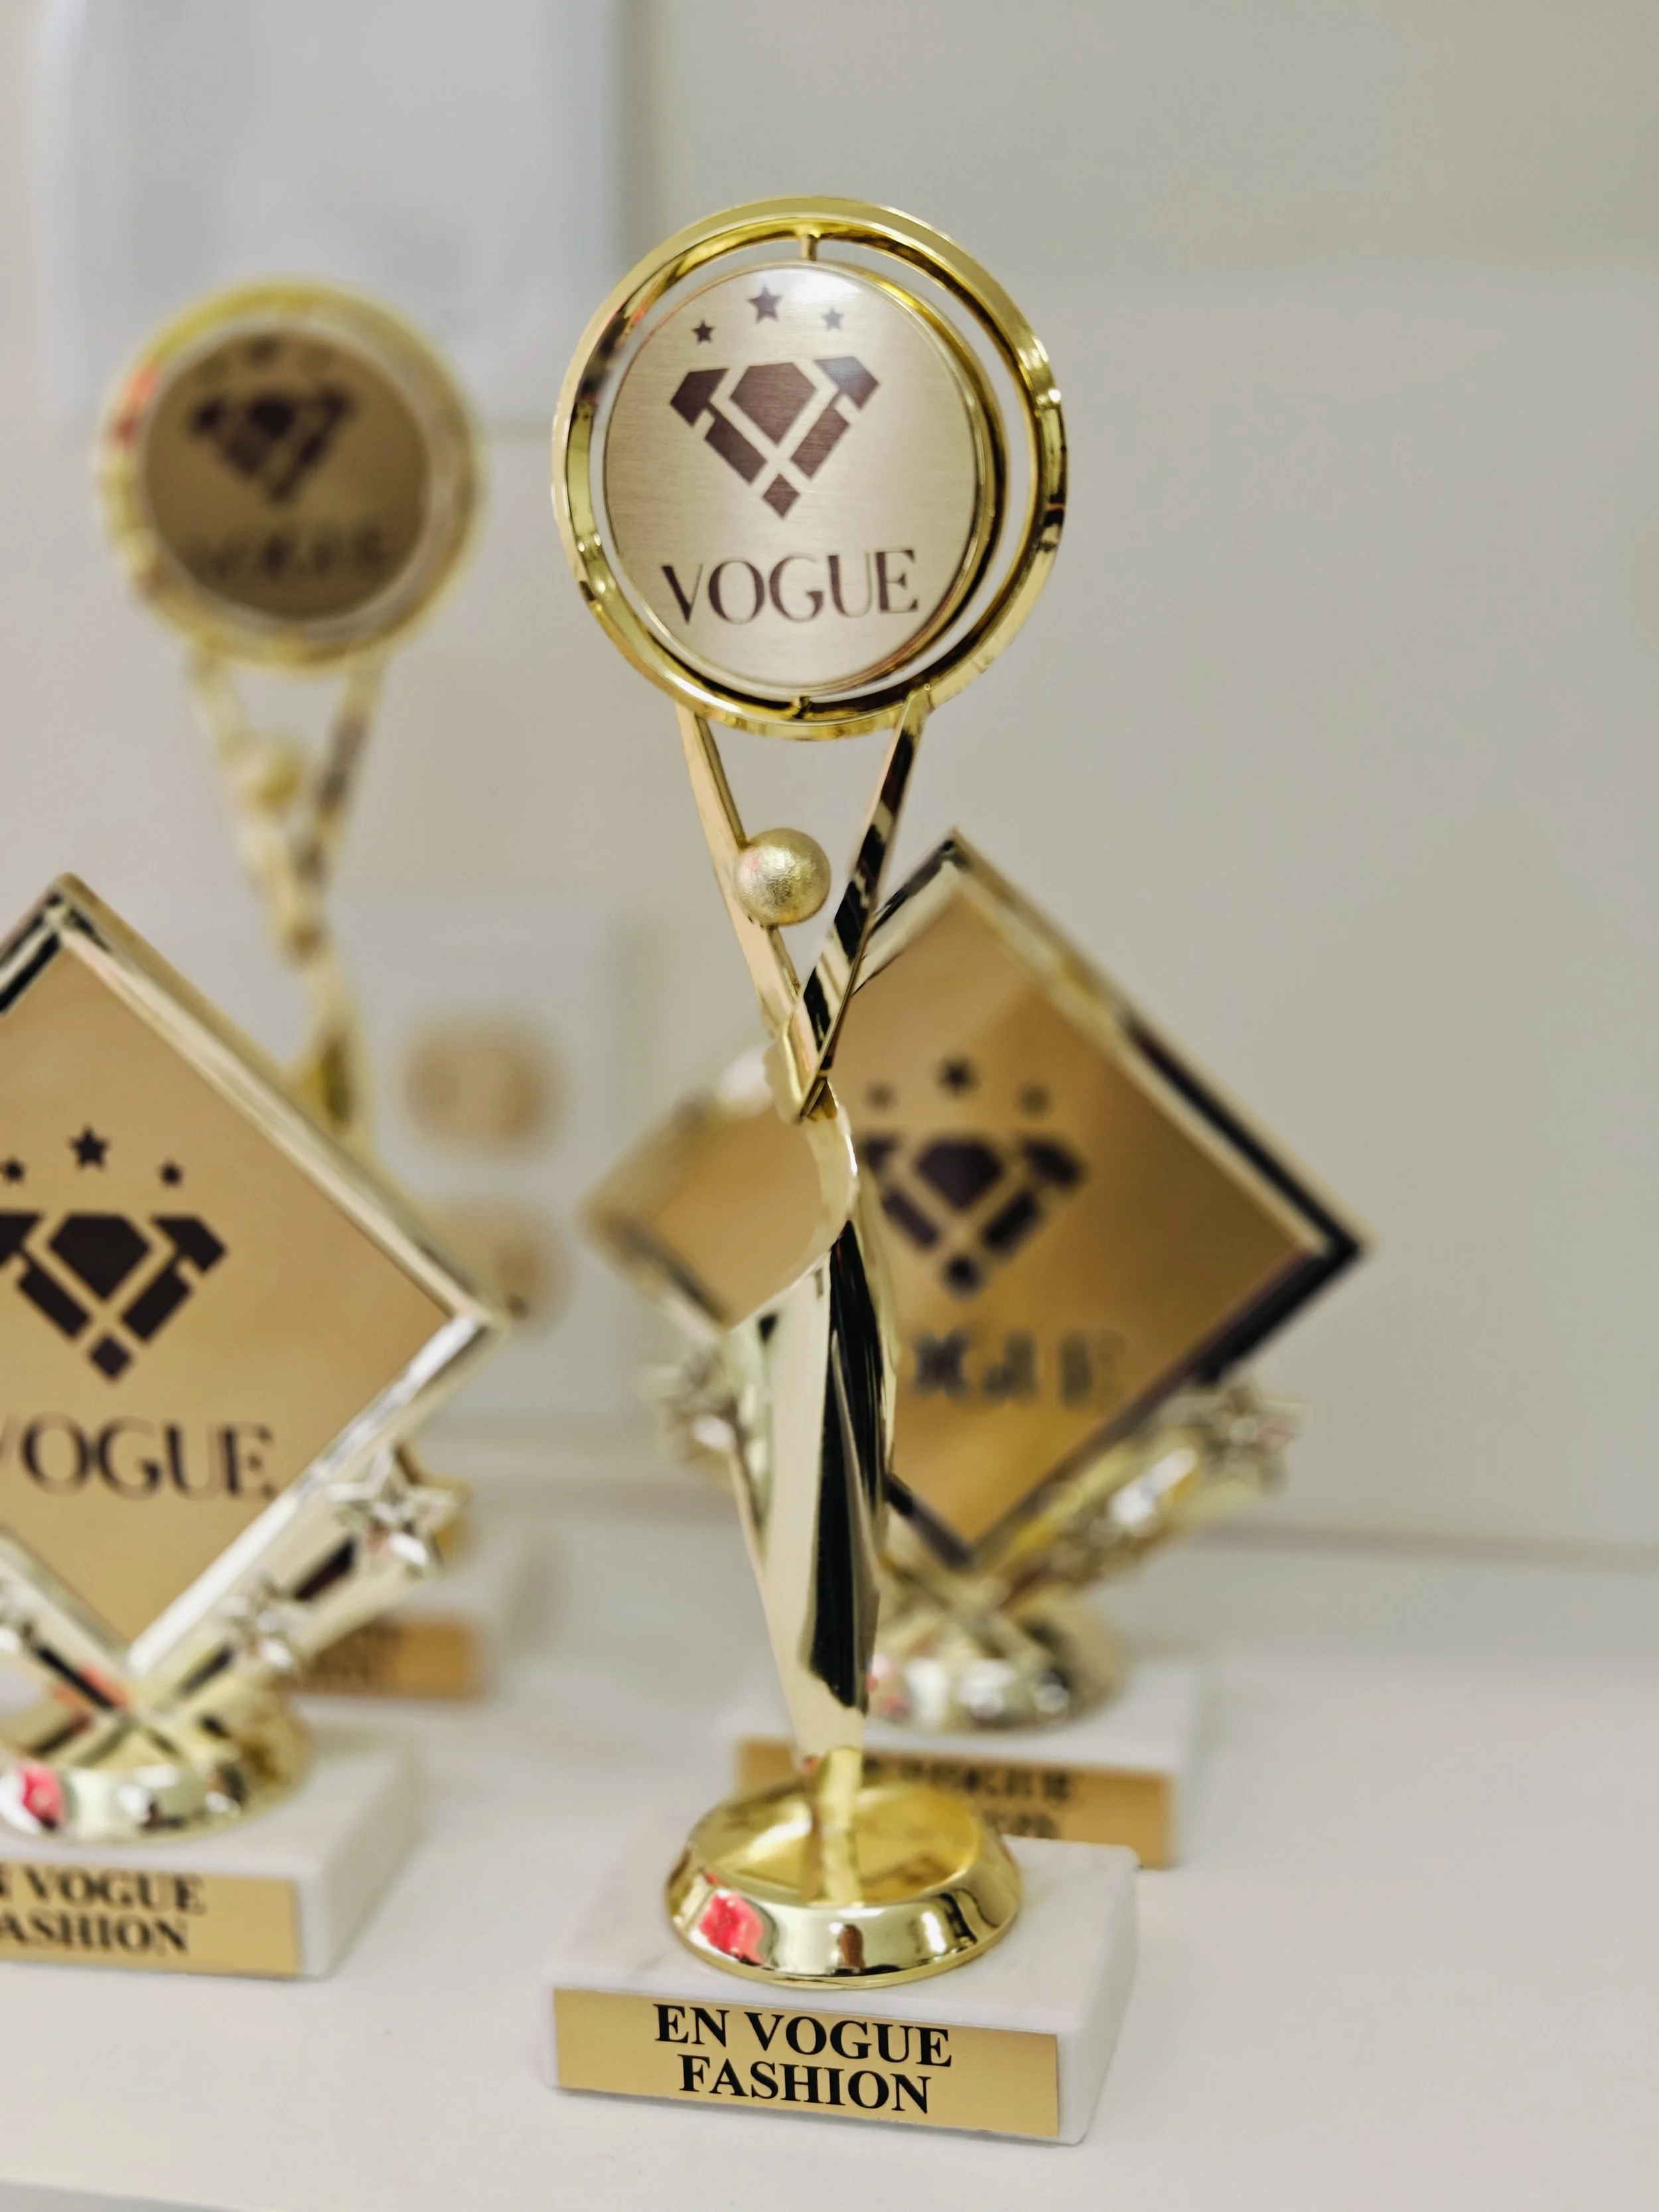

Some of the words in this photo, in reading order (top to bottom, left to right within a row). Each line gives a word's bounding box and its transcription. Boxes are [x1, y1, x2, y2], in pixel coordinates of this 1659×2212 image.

[660, 548, 920, 625] VOGUE
[23, 1866, 207, 1915] VOGUE
[0, 1909, 189, 1955] ASHION
[653, 2004, 730, 2047] EN
[744, 2012, 952, 2067] VOGUE
[677, 2054, 932, 2114] FASHION
